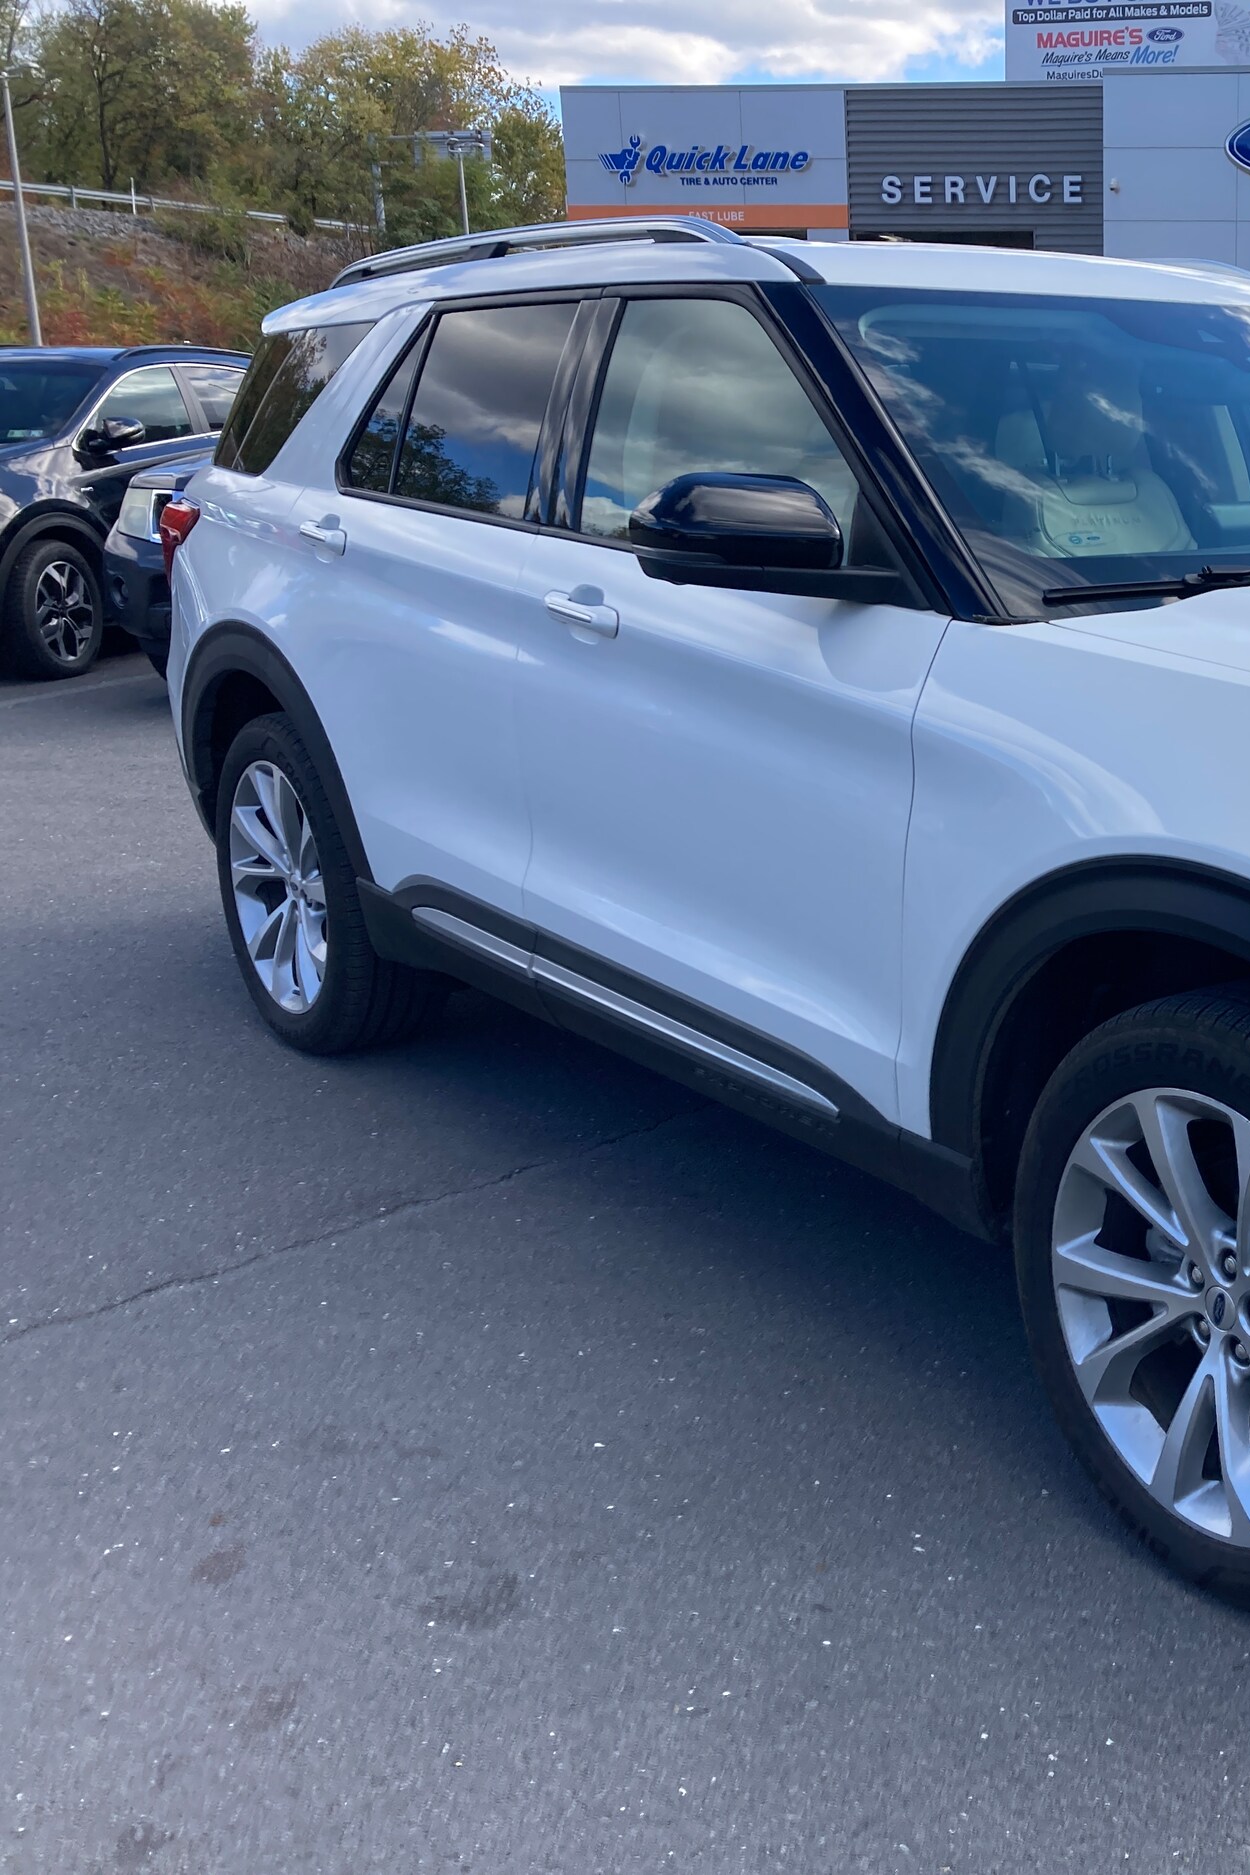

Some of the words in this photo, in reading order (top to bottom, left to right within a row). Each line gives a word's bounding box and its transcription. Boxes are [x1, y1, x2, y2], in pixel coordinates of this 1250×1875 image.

[1017, 11, 1035, 23] Top
[1037, 10, 1066, 20] Dollar
[1068, 8, 1090, 19] Paid
[1092, 8, 1107, 18] for
[1108, 6, 1123, 18] All
[1124, 6, 1157, 17] Makes
[1159, 5, 1168, 16] &
[1170, 4, 1208, 16] Models
[1036, 26, 1143, 49] MAGUIRE'S
[1153, 29, 1177, 41] Ford
[1042, 51, 1093, 67] Maguire's
[1095, 48, 1130, 62] Means
[1130, 44, 1180, 65] More!
[645, 144, 731, 175] Quick
[733, 144, 810, 172] Lane
[680, 177, 701, 186] TIRE
[703, 177, 711, 186] &
[712, 176, 738, 186] AUTO
[740, 176, 778, 186] CENTER
[881, 174, 1083, 204] SERVICE
[717, 211, 745, 221] LUBE
